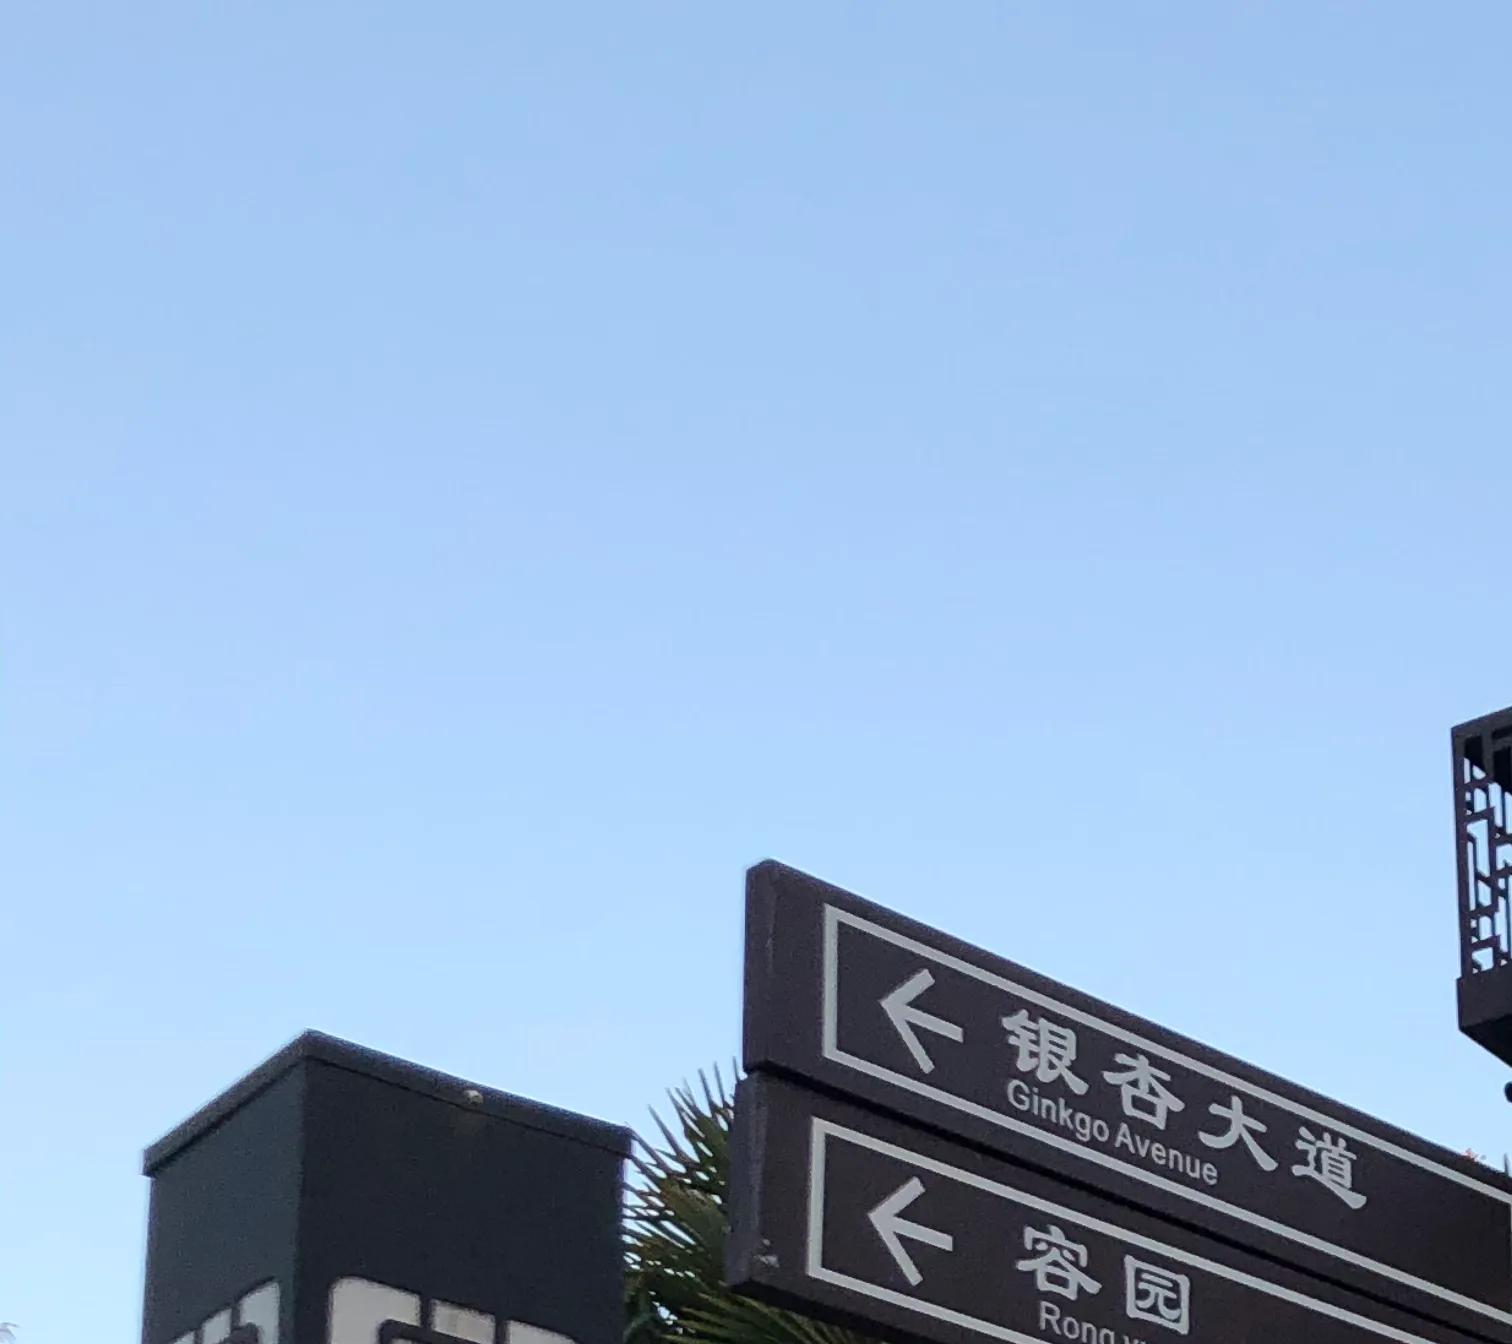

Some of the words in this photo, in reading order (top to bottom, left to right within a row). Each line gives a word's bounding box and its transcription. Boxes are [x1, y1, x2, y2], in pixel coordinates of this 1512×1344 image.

[1001, 1009, 1368, 1209] 银杏大道
[1007, 1079, 1110, 1143] Ginkgo
[1115, 1122, 1219, 1186] Avenue
[1015, 1225, 1191, 1335] 容园
